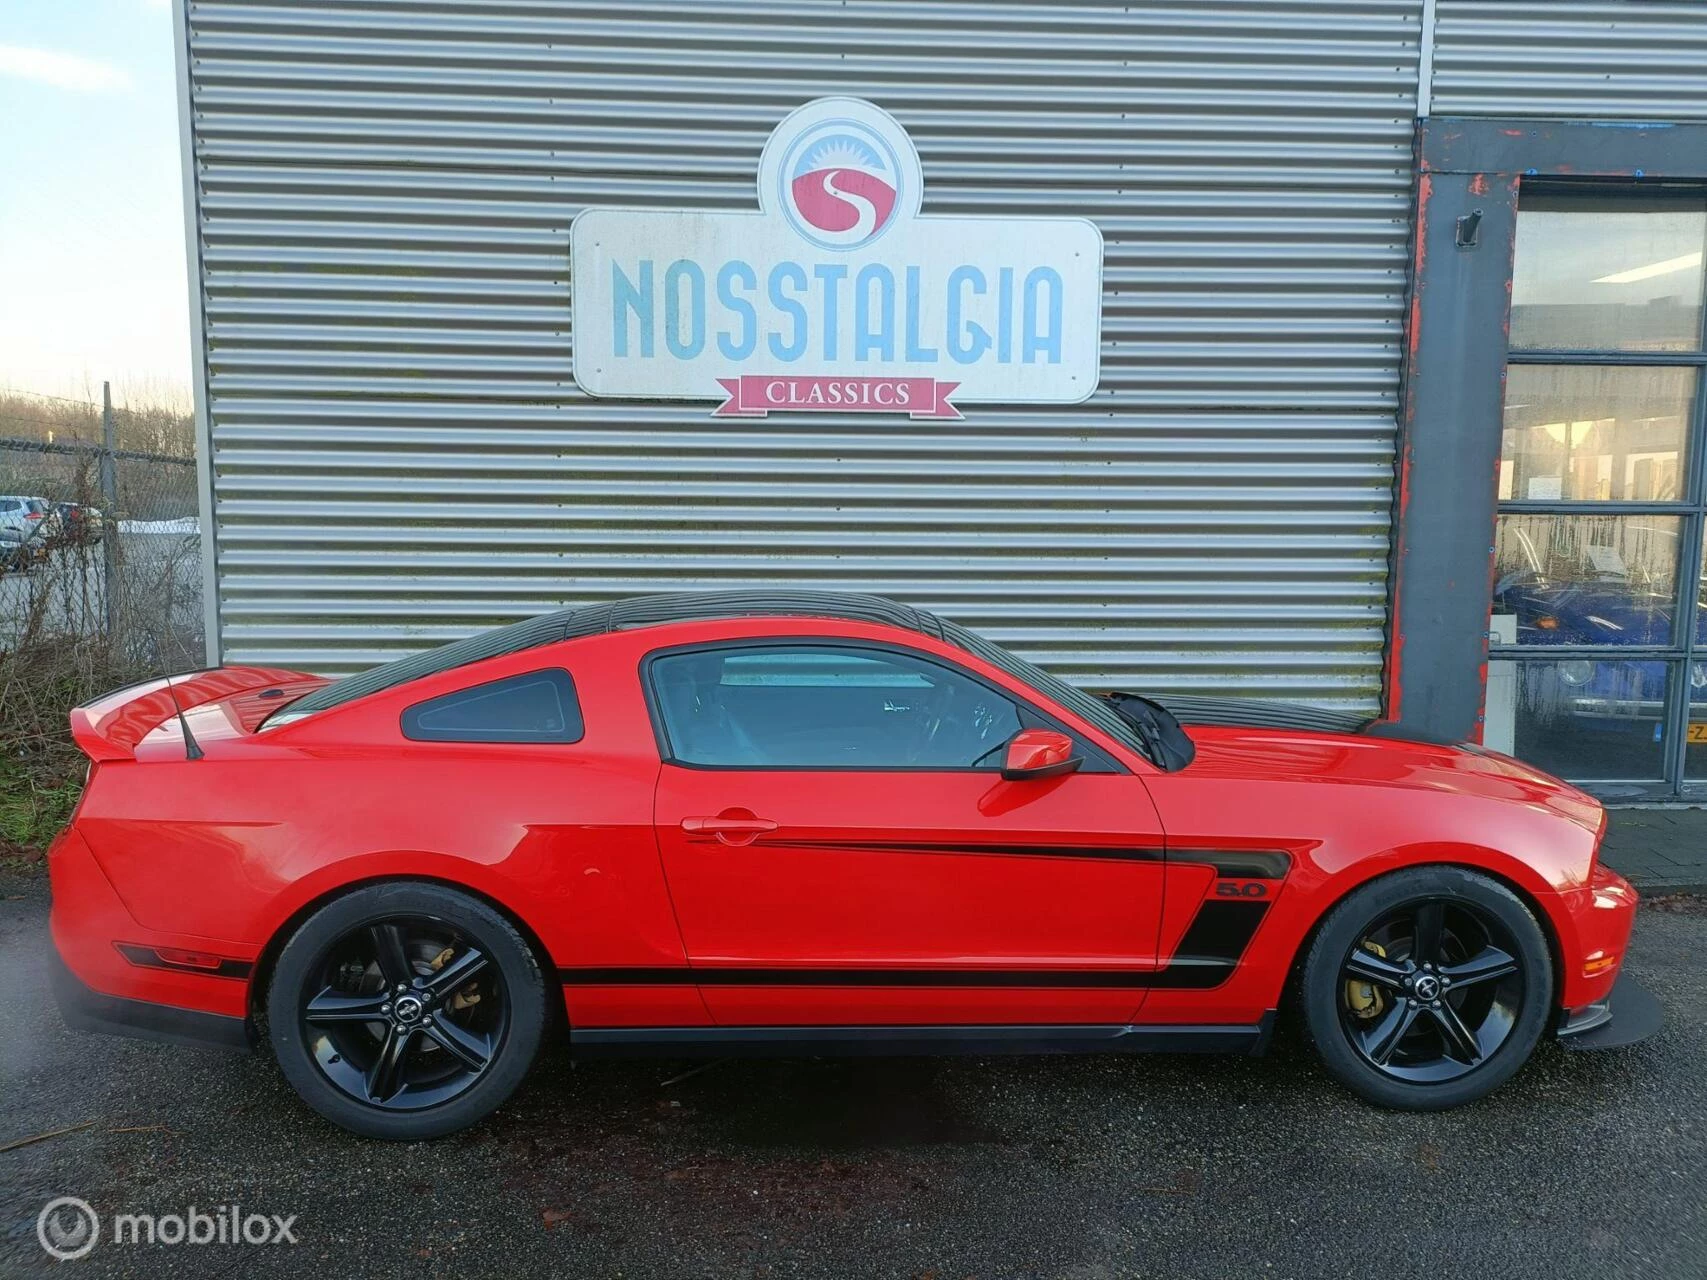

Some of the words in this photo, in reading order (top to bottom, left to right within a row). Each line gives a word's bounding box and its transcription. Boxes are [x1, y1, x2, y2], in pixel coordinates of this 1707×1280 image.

[611, 258, 1064, 365] NOSSTALGIA
[765, 381, 911, 405] CLASSICS
[1216, 882, 1267, 897] 5.0
